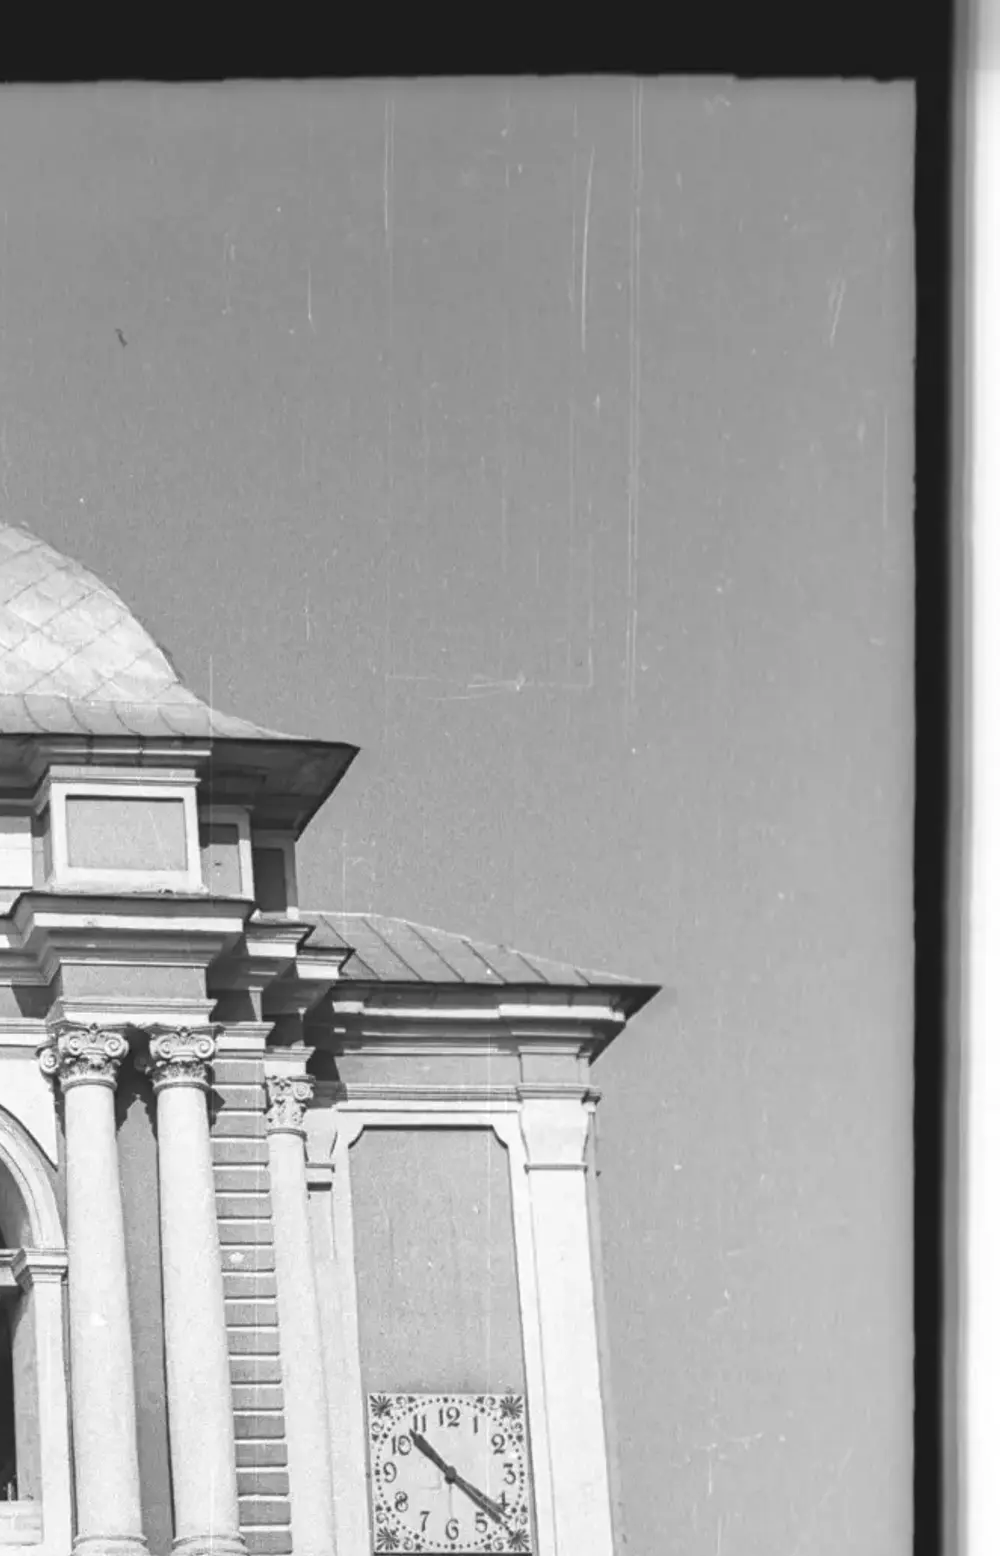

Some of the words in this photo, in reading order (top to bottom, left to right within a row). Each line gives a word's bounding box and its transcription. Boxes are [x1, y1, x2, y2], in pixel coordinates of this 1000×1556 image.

[413, 1414, 427, 1433] 11
[438, 1406, 461, 1427] 12
[472, 1415, 478, 1434] 1
[391, 1435, 412, 1456] 10
[491, 1434, 506, 1455] 2
[383, 1461, 397, 1483] 9
[503, 1463, 516, 1485] 3
[394, 1491, 409, 1513] 8
[420, 1511, 431, 1532] 7
[445, 1518, 459, 1540] 6
[475, 1512, 488, 1533] 5
